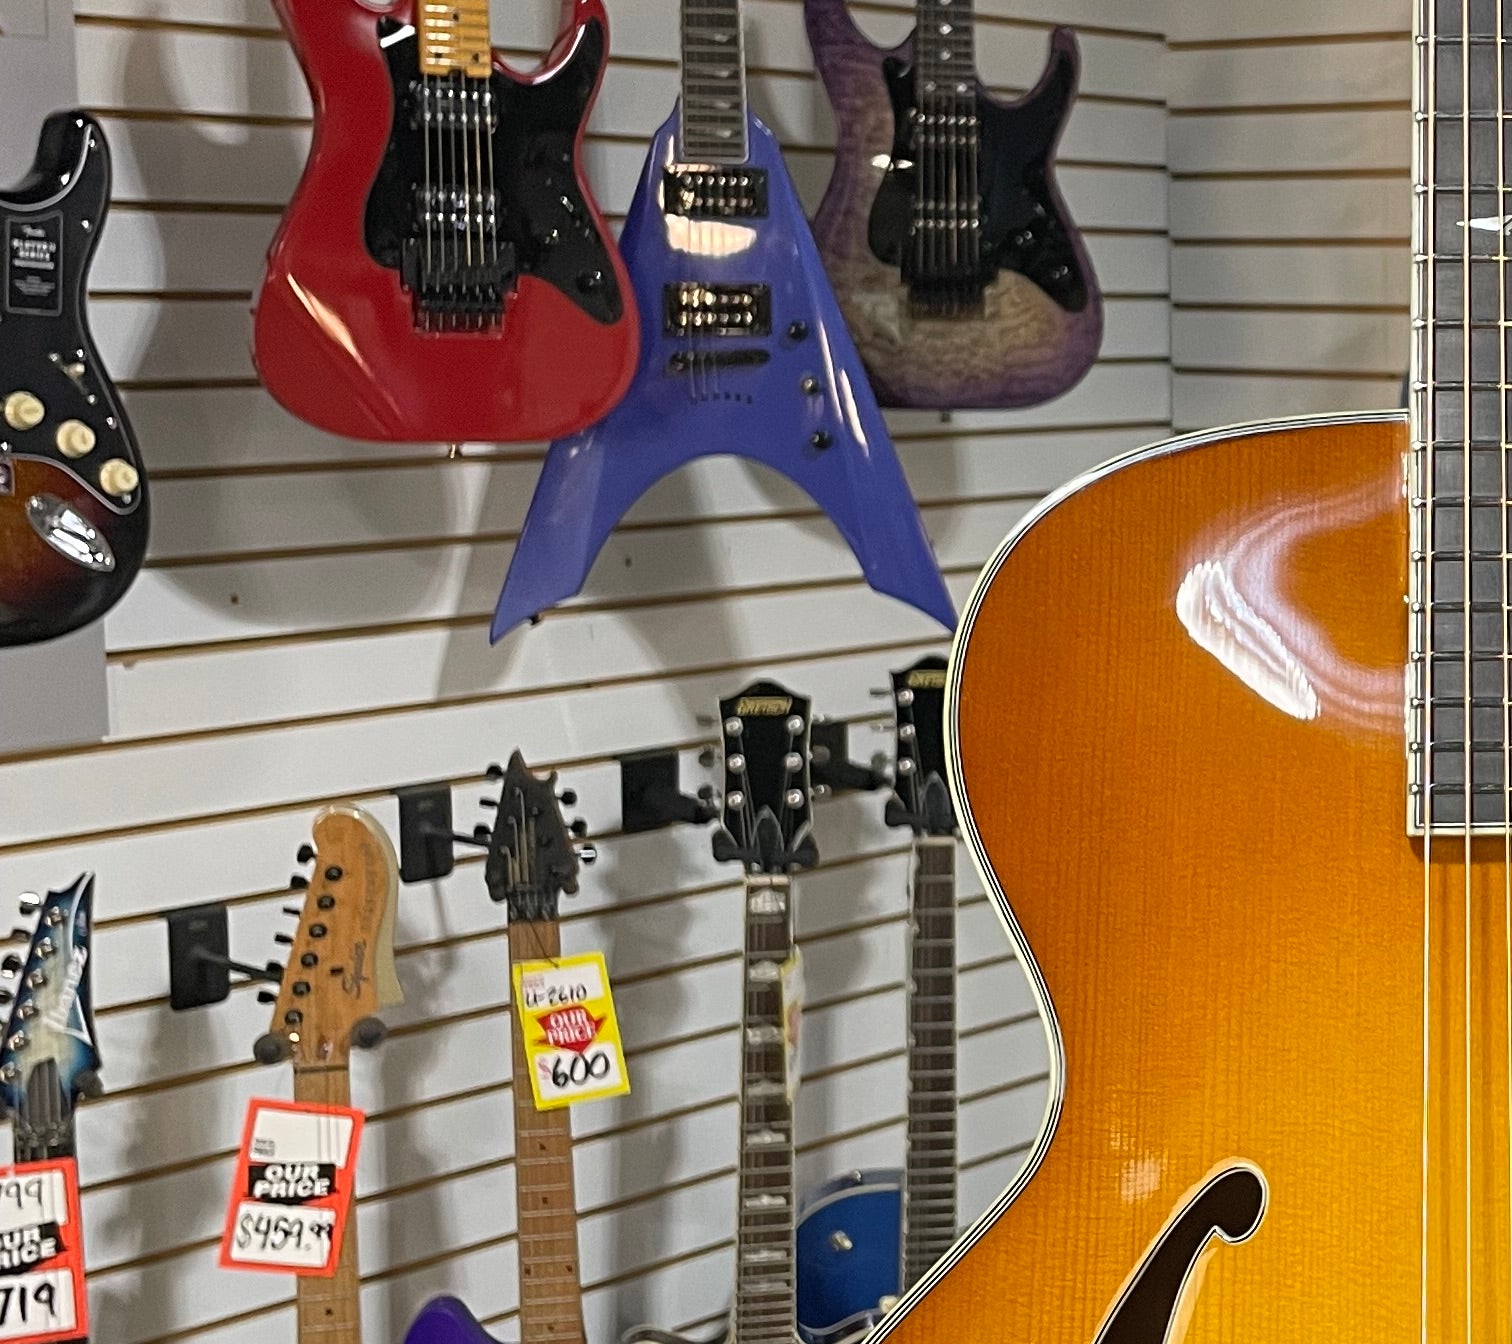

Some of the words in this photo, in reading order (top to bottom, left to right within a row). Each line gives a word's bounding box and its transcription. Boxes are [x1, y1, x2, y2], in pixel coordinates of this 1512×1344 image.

[538, 1050, 611, 1089] $600
[264, 1163, 320, 1184] OUR
[0, 1178, 43, 1210] 99
[253, 1177, 331, 1199] PRICE
[0, 1227, 41, 1248] UR
[0, 1236, 57, 1271] RICE
